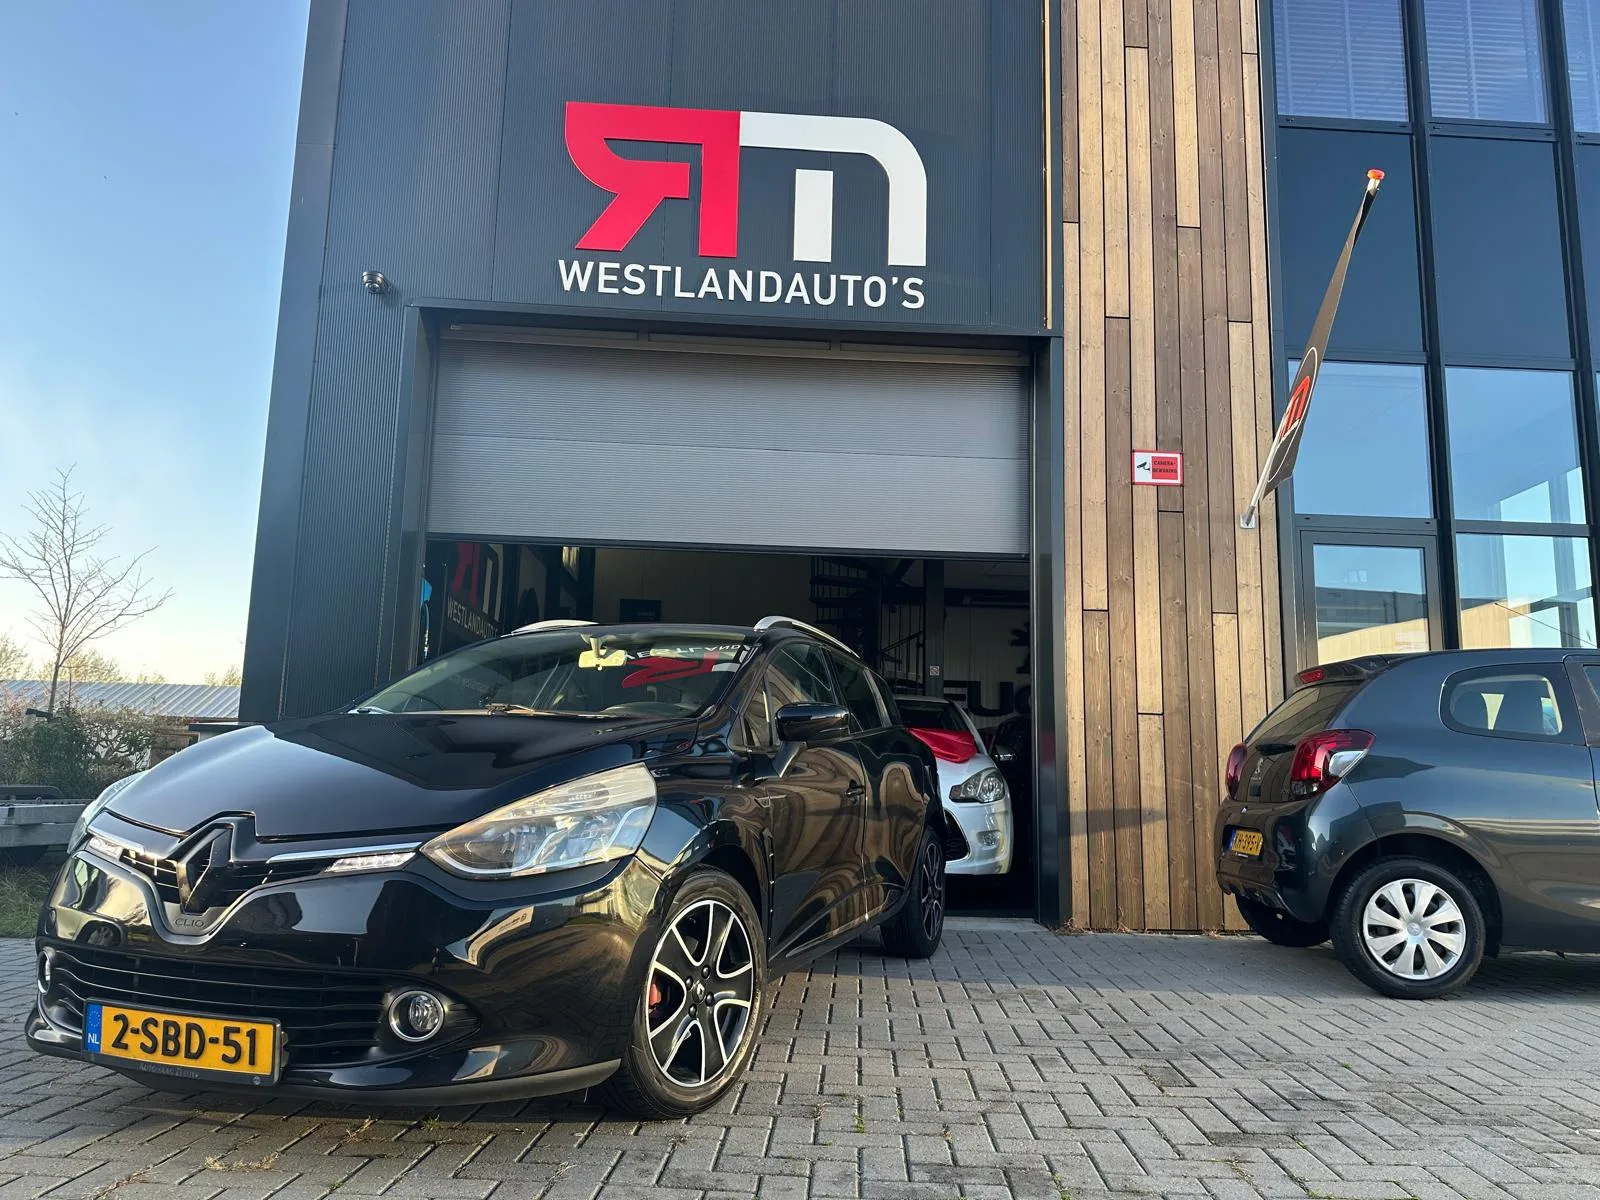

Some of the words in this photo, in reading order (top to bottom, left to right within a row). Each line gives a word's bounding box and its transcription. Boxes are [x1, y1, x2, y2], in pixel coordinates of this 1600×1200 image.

[557, 258, 926, 310] WESTLANDAUTO'S
[175, 918, 204, 928] CLIO
[88, 1033, 99, 1044] NL
[111, 1013, 257, 1066] 2-SBD-51
